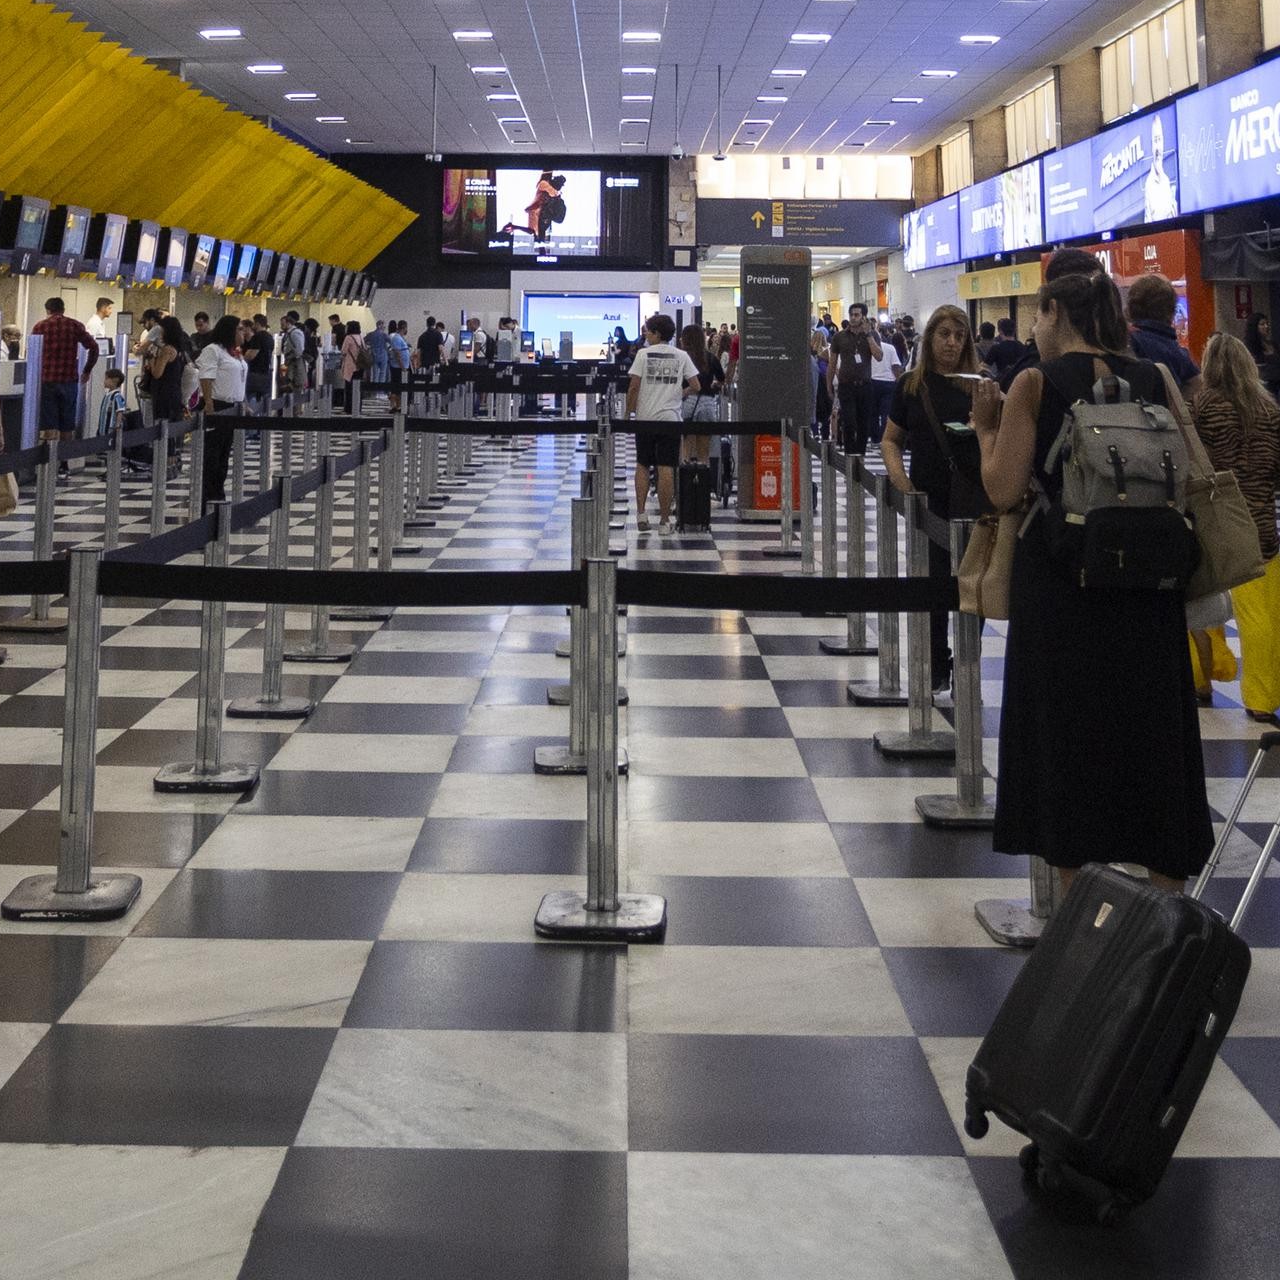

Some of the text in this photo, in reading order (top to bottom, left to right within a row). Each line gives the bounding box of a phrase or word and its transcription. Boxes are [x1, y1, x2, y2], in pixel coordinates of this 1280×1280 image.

[1231, 89, 1258, 112] BANCO
[1100, 136, 1144, 189] MERCANTIL
[1144, 245, 1156, 260] LOJA
[746, 275, 789, 285] Premium
